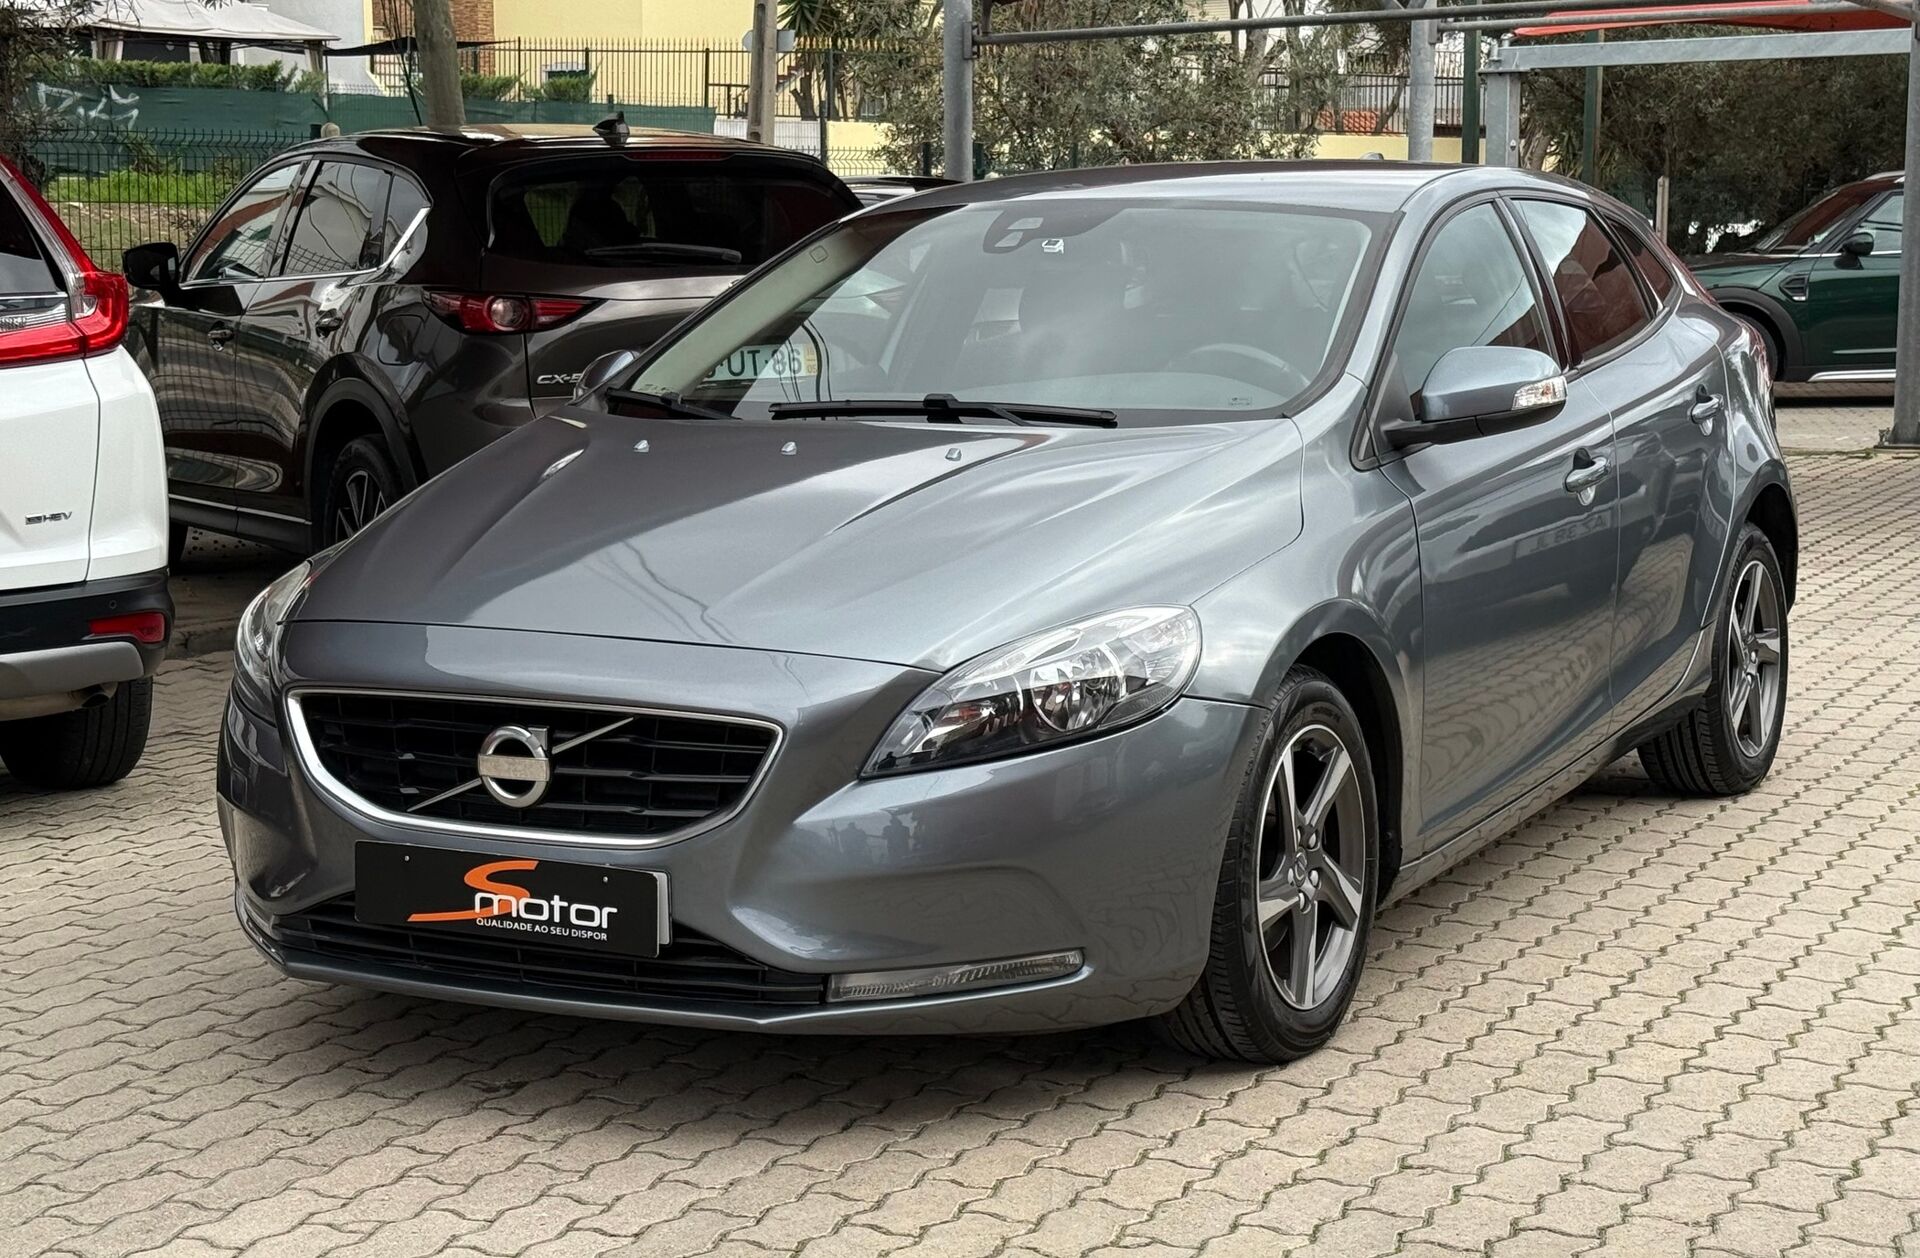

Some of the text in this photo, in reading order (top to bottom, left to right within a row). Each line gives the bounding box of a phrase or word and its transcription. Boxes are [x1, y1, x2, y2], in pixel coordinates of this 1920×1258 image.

[536, 373, 582, 385] CX-5
[474, 892, 618, 929] motor
[476, 917, 608, 941] QUALIDADE AO SEU DISPOR
